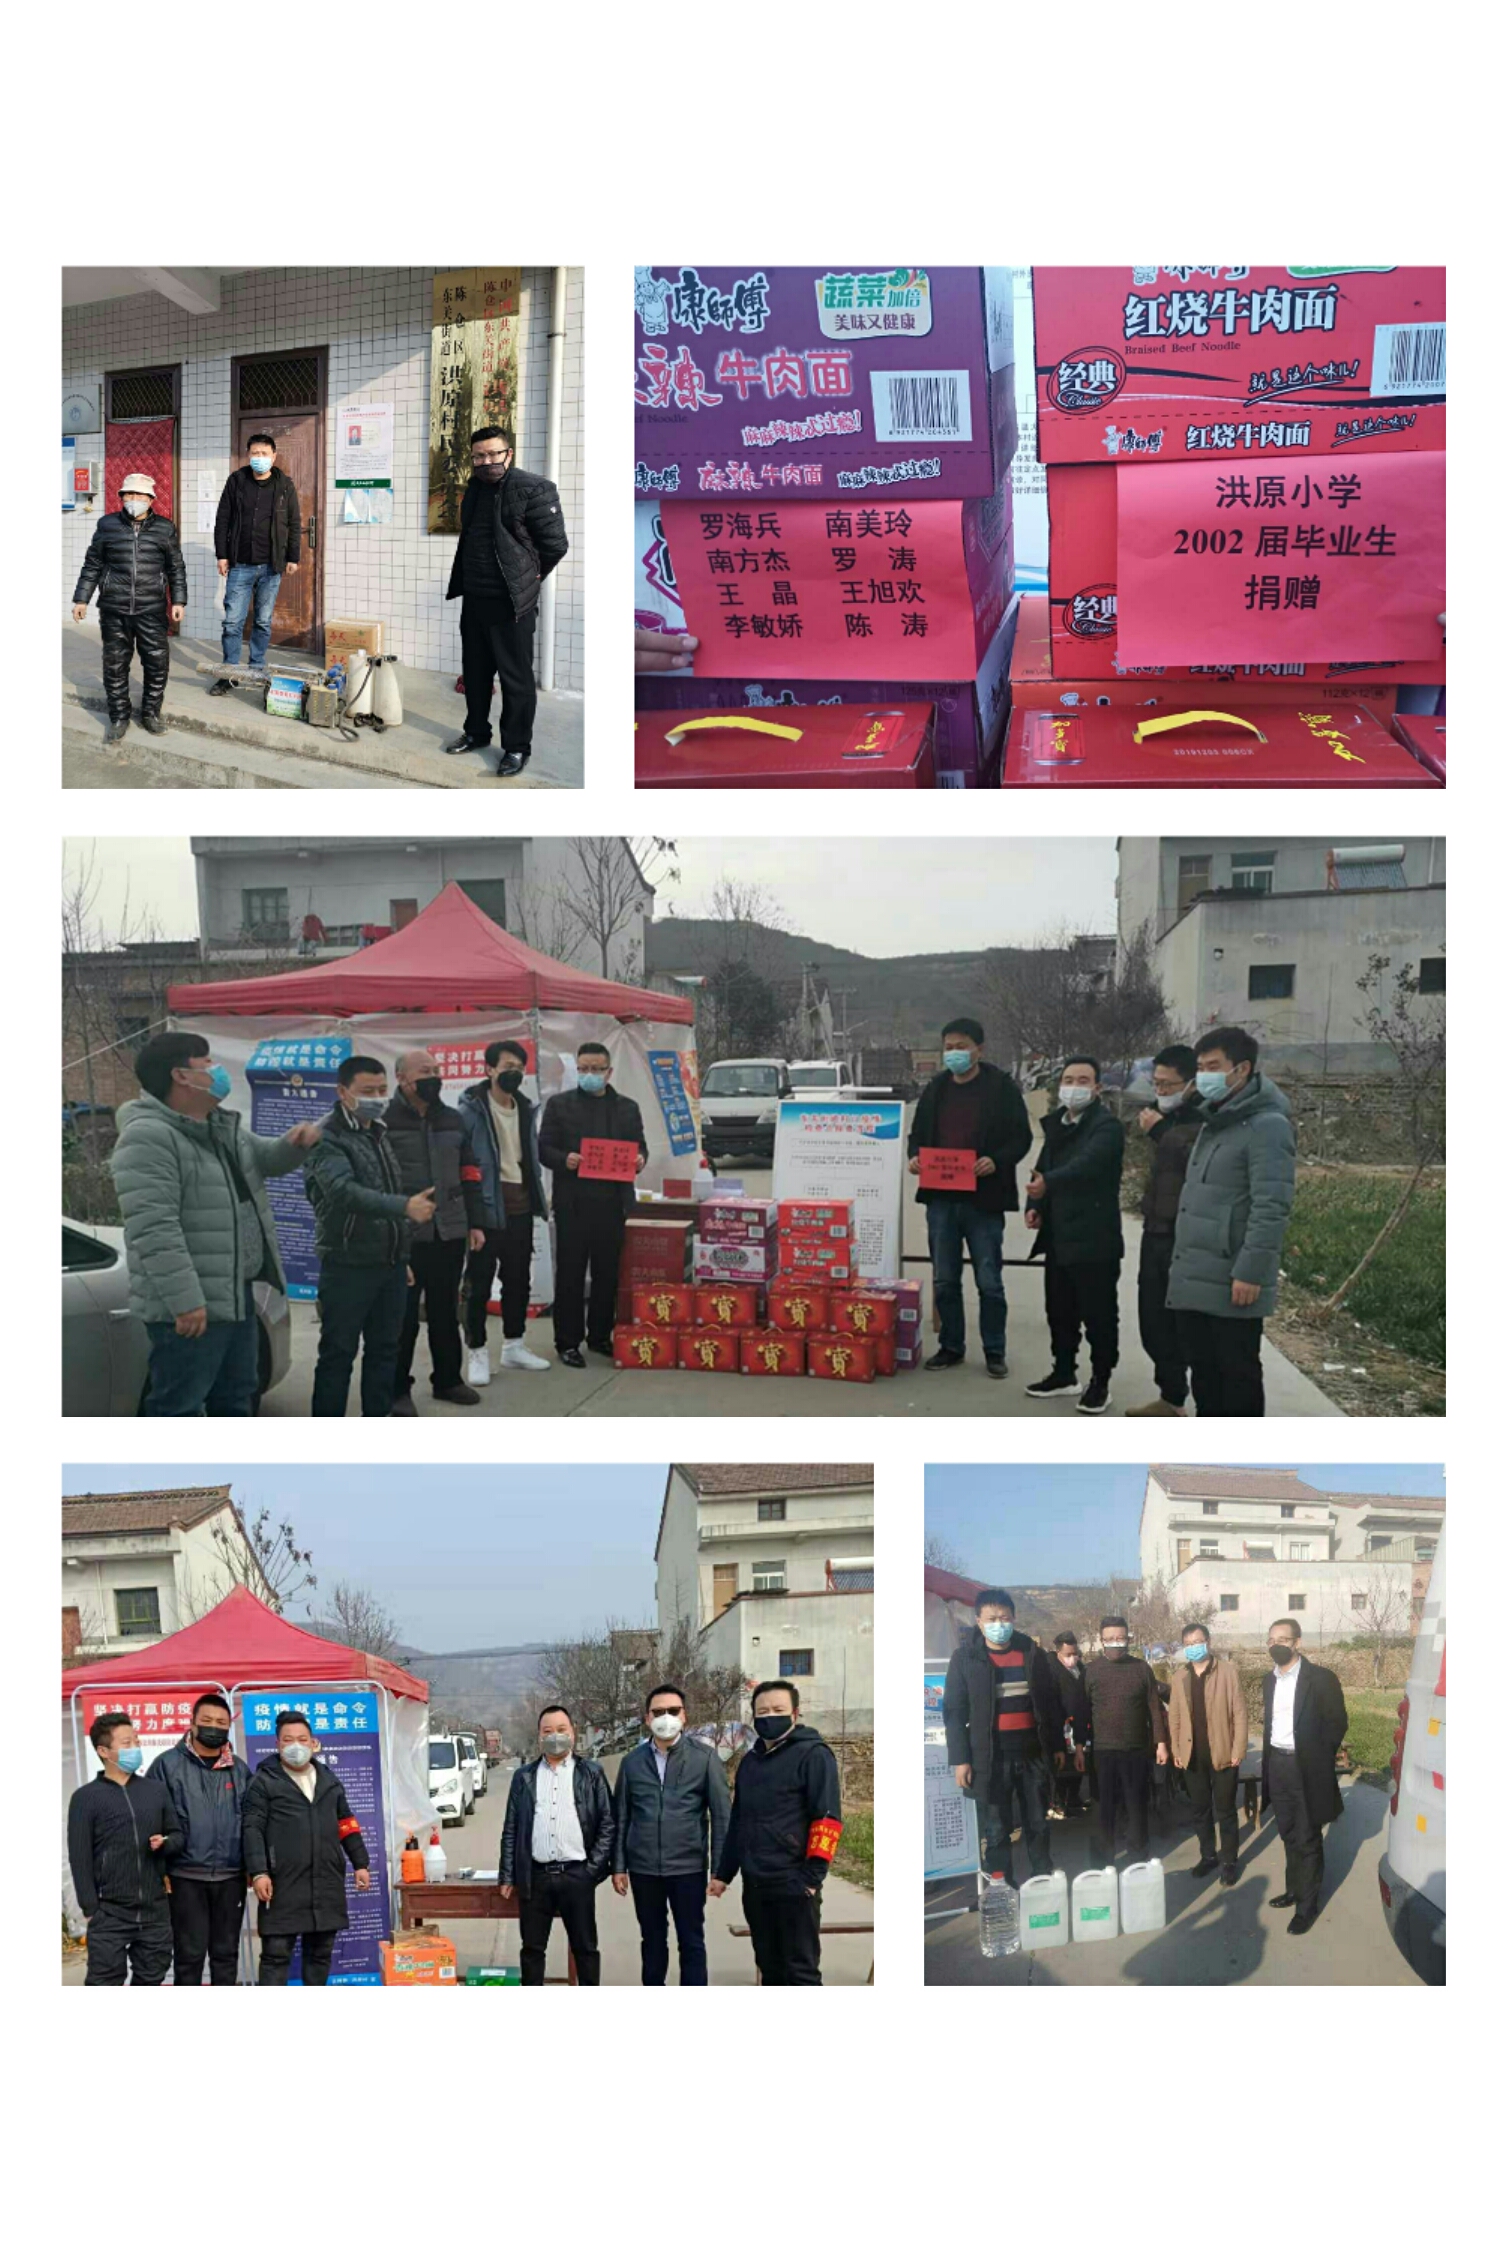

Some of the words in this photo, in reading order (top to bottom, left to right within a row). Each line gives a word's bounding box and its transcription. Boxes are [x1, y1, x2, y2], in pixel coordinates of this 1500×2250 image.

[440, 286, 453, 356] 东关街道
[454, 285, 467, 355] 陈仓区
[834, 313, 916, 331] 美味又健康
[1123, 284, 1338, 340] 红烧牛肉面
[1125, 345, 1166, 355] Braised
[1172, 343, 1195, 353] Beef
[1201, 341, 1241, 351] Noodle
[1058, 360, 1117, 393] 经典
[1186, 420, 1312, 450] 红烧牛肉面
[697, 460, 823, 491] 麻辣牛肉面
[1215, 474, 1361, 509] 洪原小学
[700, 511, 781, 540] 罗海兵
[825, 508, 912, 538] 南美玲
[1174, 529, 1243, 554] 2002
[1255, 524, 1396, 557] 届毕业生
[707, 548, 790, 574] 南方杰
[832, 547, 856, 571] 罗
[888, 546, 917, 571] 涛
[716, 583, 744, 606] 王
[773, 581, 798, 606] 晶
[840, 578, 925, 604] 王旭欢
[1244, 574, 1320, 611] 捐赠
[724, 613, 804, 638] 李敏娇
[845, 613, 873, 637] 陈
[901, 612, 928, 637] 涛
[254, 1701, 367, 1716] 疫情就是命令
